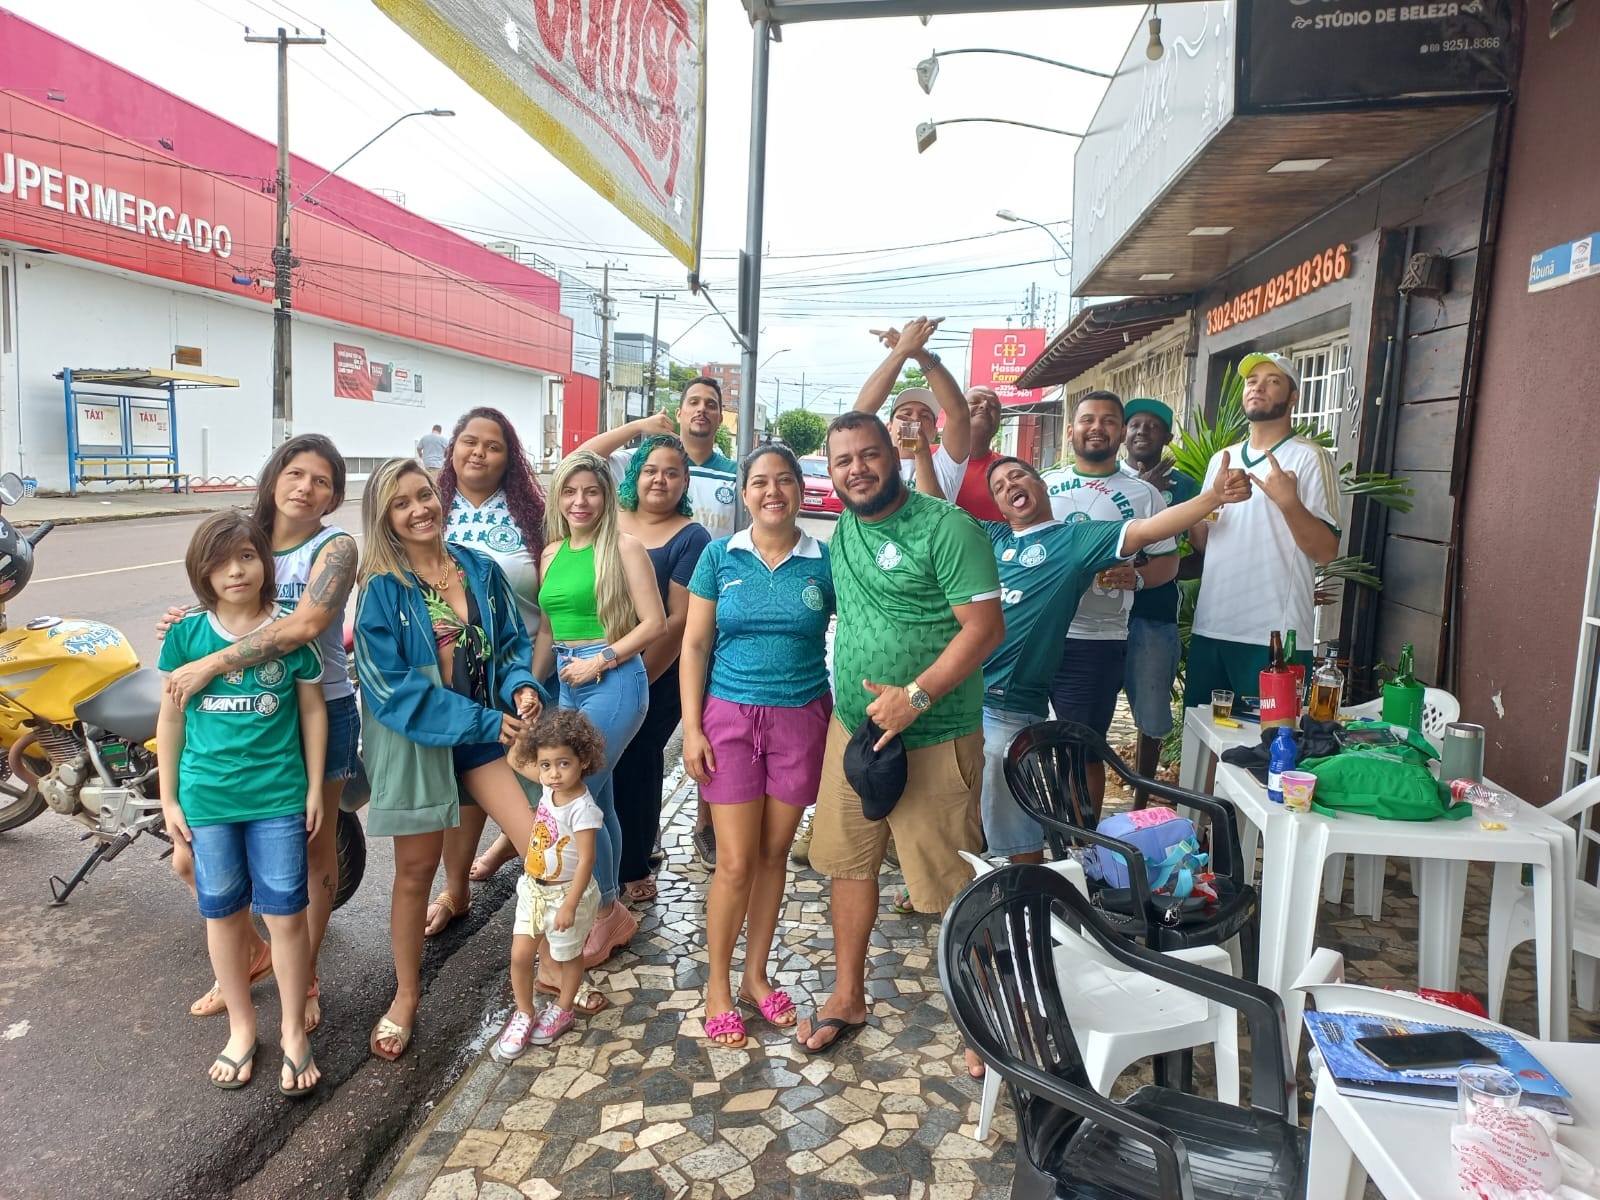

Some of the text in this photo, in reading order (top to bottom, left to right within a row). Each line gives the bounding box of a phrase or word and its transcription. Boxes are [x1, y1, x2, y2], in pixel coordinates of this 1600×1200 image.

[1315, 1, 1458, 29] STÚDIO DE BELEZA
[1443, 37, 1500, 51] 9251.8366
[992, 372, 1020, 381] Farm
[1049, 477, 1081, 495] CHA
[203, 697, 251, 711] AVANTI
